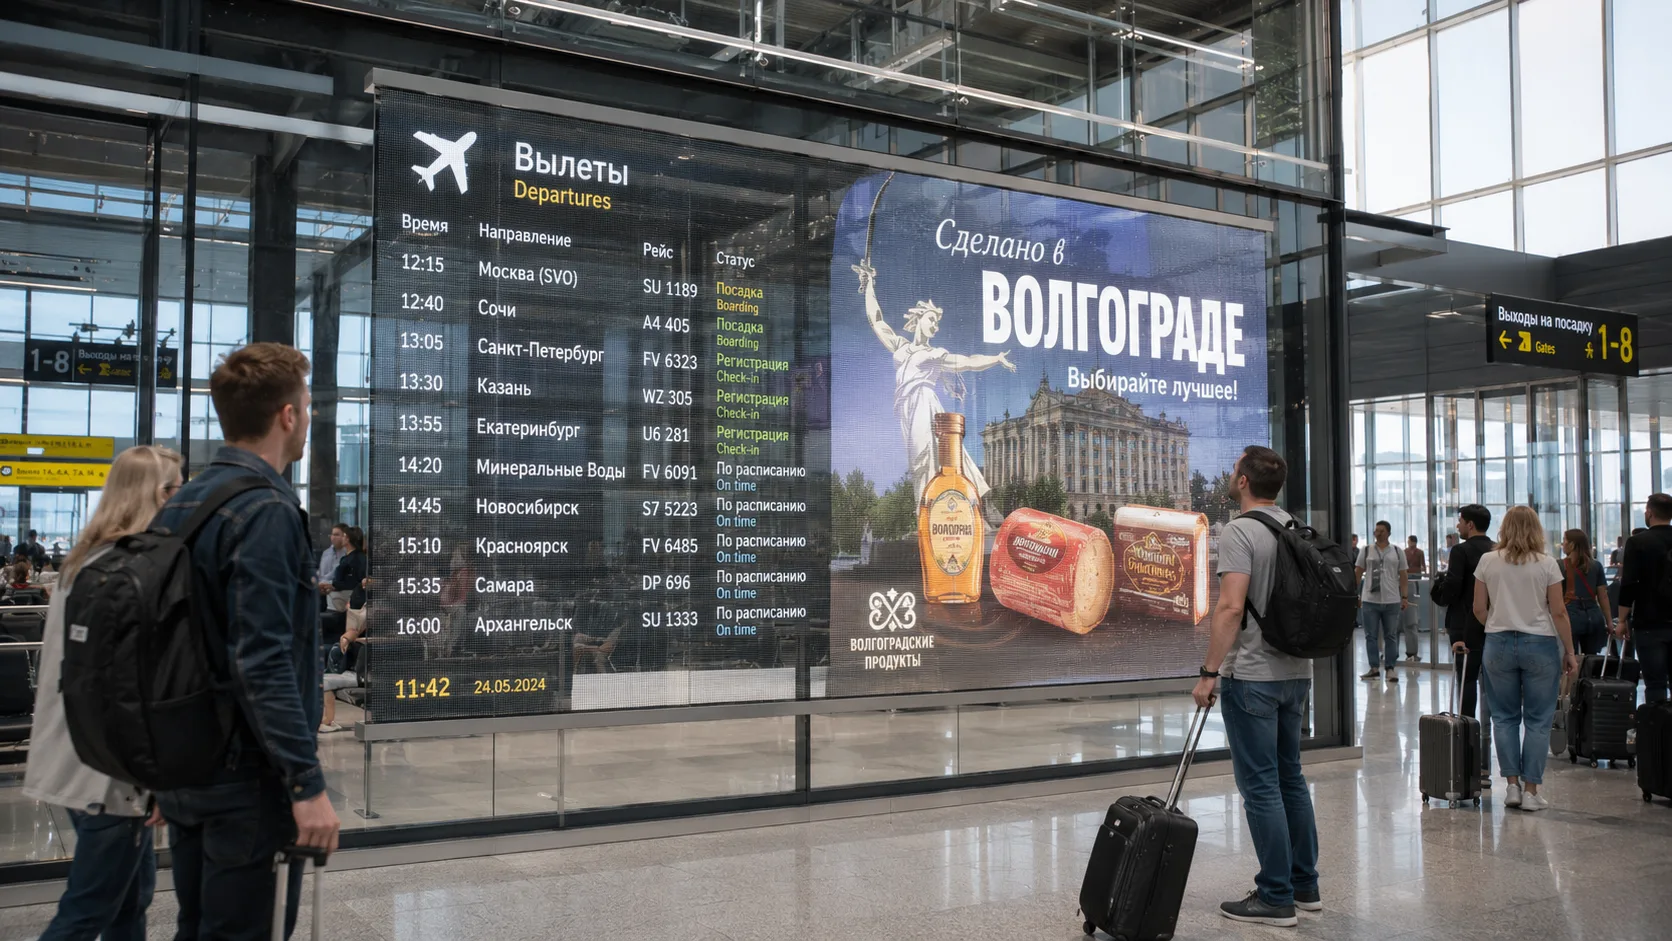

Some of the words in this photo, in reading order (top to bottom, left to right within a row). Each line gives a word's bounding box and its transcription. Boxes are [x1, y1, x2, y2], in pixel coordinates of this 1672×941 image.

[514, 141, 629, 186] Вылеты
[514, 179, 612, 210] Departures
[402, 213, 449, 233] Время
[479, 223, 572, 248] Направление
[935, 218, 1045, 264] Сделано
[1053, 238, 1066, 265] в
[643, 242, 674, 260] Рейс
[401, 253, 444, 273] 12:15
[716, 251, 755, 270] Статус
[479, 261, 535, 282] Москва
[539, 266, 578, 289] (SVO)
[643, 278, 661, 294] SU
[666, 281, 698, 298] 1189
[716, 281, 764, 299] Посадка
[401, 293, 444, 312] 12:40
[478, 299, 516, 318] Сочи
[716, 299, 759, 316] Boarding
[643, 314, 661, 331] A4
[665, 317, 690, 333] 405
[716, 317, 764, 334] Посадка
[982, 270, 1245, 375] ВОЛГОГРАДЕ
[1498, 306, 1538, 327] Выходы
[1541, 315, 1552, 327] на
[1555, 317, 1593, 336] посадку
[401, 332, 443, 350] 13:05
[716, 334, 759, 351] Boarding
[1535, 341, 1556, 355] Gates
[1598, 323, 1633, 363] 1-8
[31, 348, 70, 373] 1-8
[478, 338, 605, 365] Санкт-Петербург
[643, 351, 661, 368] FV
[665, 353, 698, 370] 6323
[716, 352, 789, 372] Регистрация
[399, 373, 443, 391] 13:30
[716, 370, 760, 384] Check-in
[1068, 366, 1167, 396] Выбирайте
[1172, 379, 1238, 402] лучшее!
[477, 377, 532, 396] Казань
[643, 388, 664, 404] WZ
[668, 390, 693, 406] 305
[716, 389, 789, 407] Регистрация
[716, 406, 760, 420] Check-in
[399, 414, 443, 432] 13:55
[477, 418, 581, 440] Екатеринбург
[643, 426, 661, 441] U6
[665, 427, 690, 443] 281
[716, 425, 789, 443] Регистрация
[716, 442, 760, 456] Check-in
[399, 456, 442, 474] 14:20
[476, 458, 584, 480] Минеральные
[588, 462, 626, 481] Воды
[643, 463, 660, 479] FV
[665, 465, 698, 480] 6091
[716, 461, 733, 476] По
[735, 465, 806, 480] расписанию
[716, 478, 731, 491] On
[734, 478, 757, 492] time
[398, 497, 442, 514] 14:45
[476, 497, 579, 519] Новосибирск
[642, 501, 660, 516] S7
[665, 501, 698, 516] 5223
[716, 497, 733, 511] По
[735, 500, 806, 515] расписанию
[716, 514, 731, 527] On
[734, 514, 757, 527] time
[398, 537, 441, 554] 15:10
[475, 536, 568, 557] Красноярск
[642, 538, 660, 553] FV
[665, 538, 698, 553] 6485
[716, 534, 733, 547] По
[735, 536, 806, 550] расписанию
[716, 551, 731, 563] On
[734, 550, 757, 563] time
[397, 577, 441, 594] 15:35
[475, 576, 534, 595] Самара
[642, 575, 661, 590] DP
[665, 574, 691, 590] 696
[716, 569, 733, 583] По
[735, 571, 806, 586] расписанию
[716, 587, 731, 599] On
[734, 586, 757, 599] time
[642, 612, 661, 627] SU
[665, 611, 698, 627] 1333
[716, 606, 733, 620] По
[735, 606, 806, 623] расписанию
[396, 617, 441, 635] 16:00
[475, 615, 573, 637] Архангельск
[716, 623, 731, 636] On
[734, 623, 757, 636] time
[850, 635, 935, 652] ВОЛГОГРАДСКИЕ
[865, 653, 921, 670] ПРОДУКТЫ
[395, 677, 451, 699] 11:42
[474, 677, 546, 695] 24.05.2024
